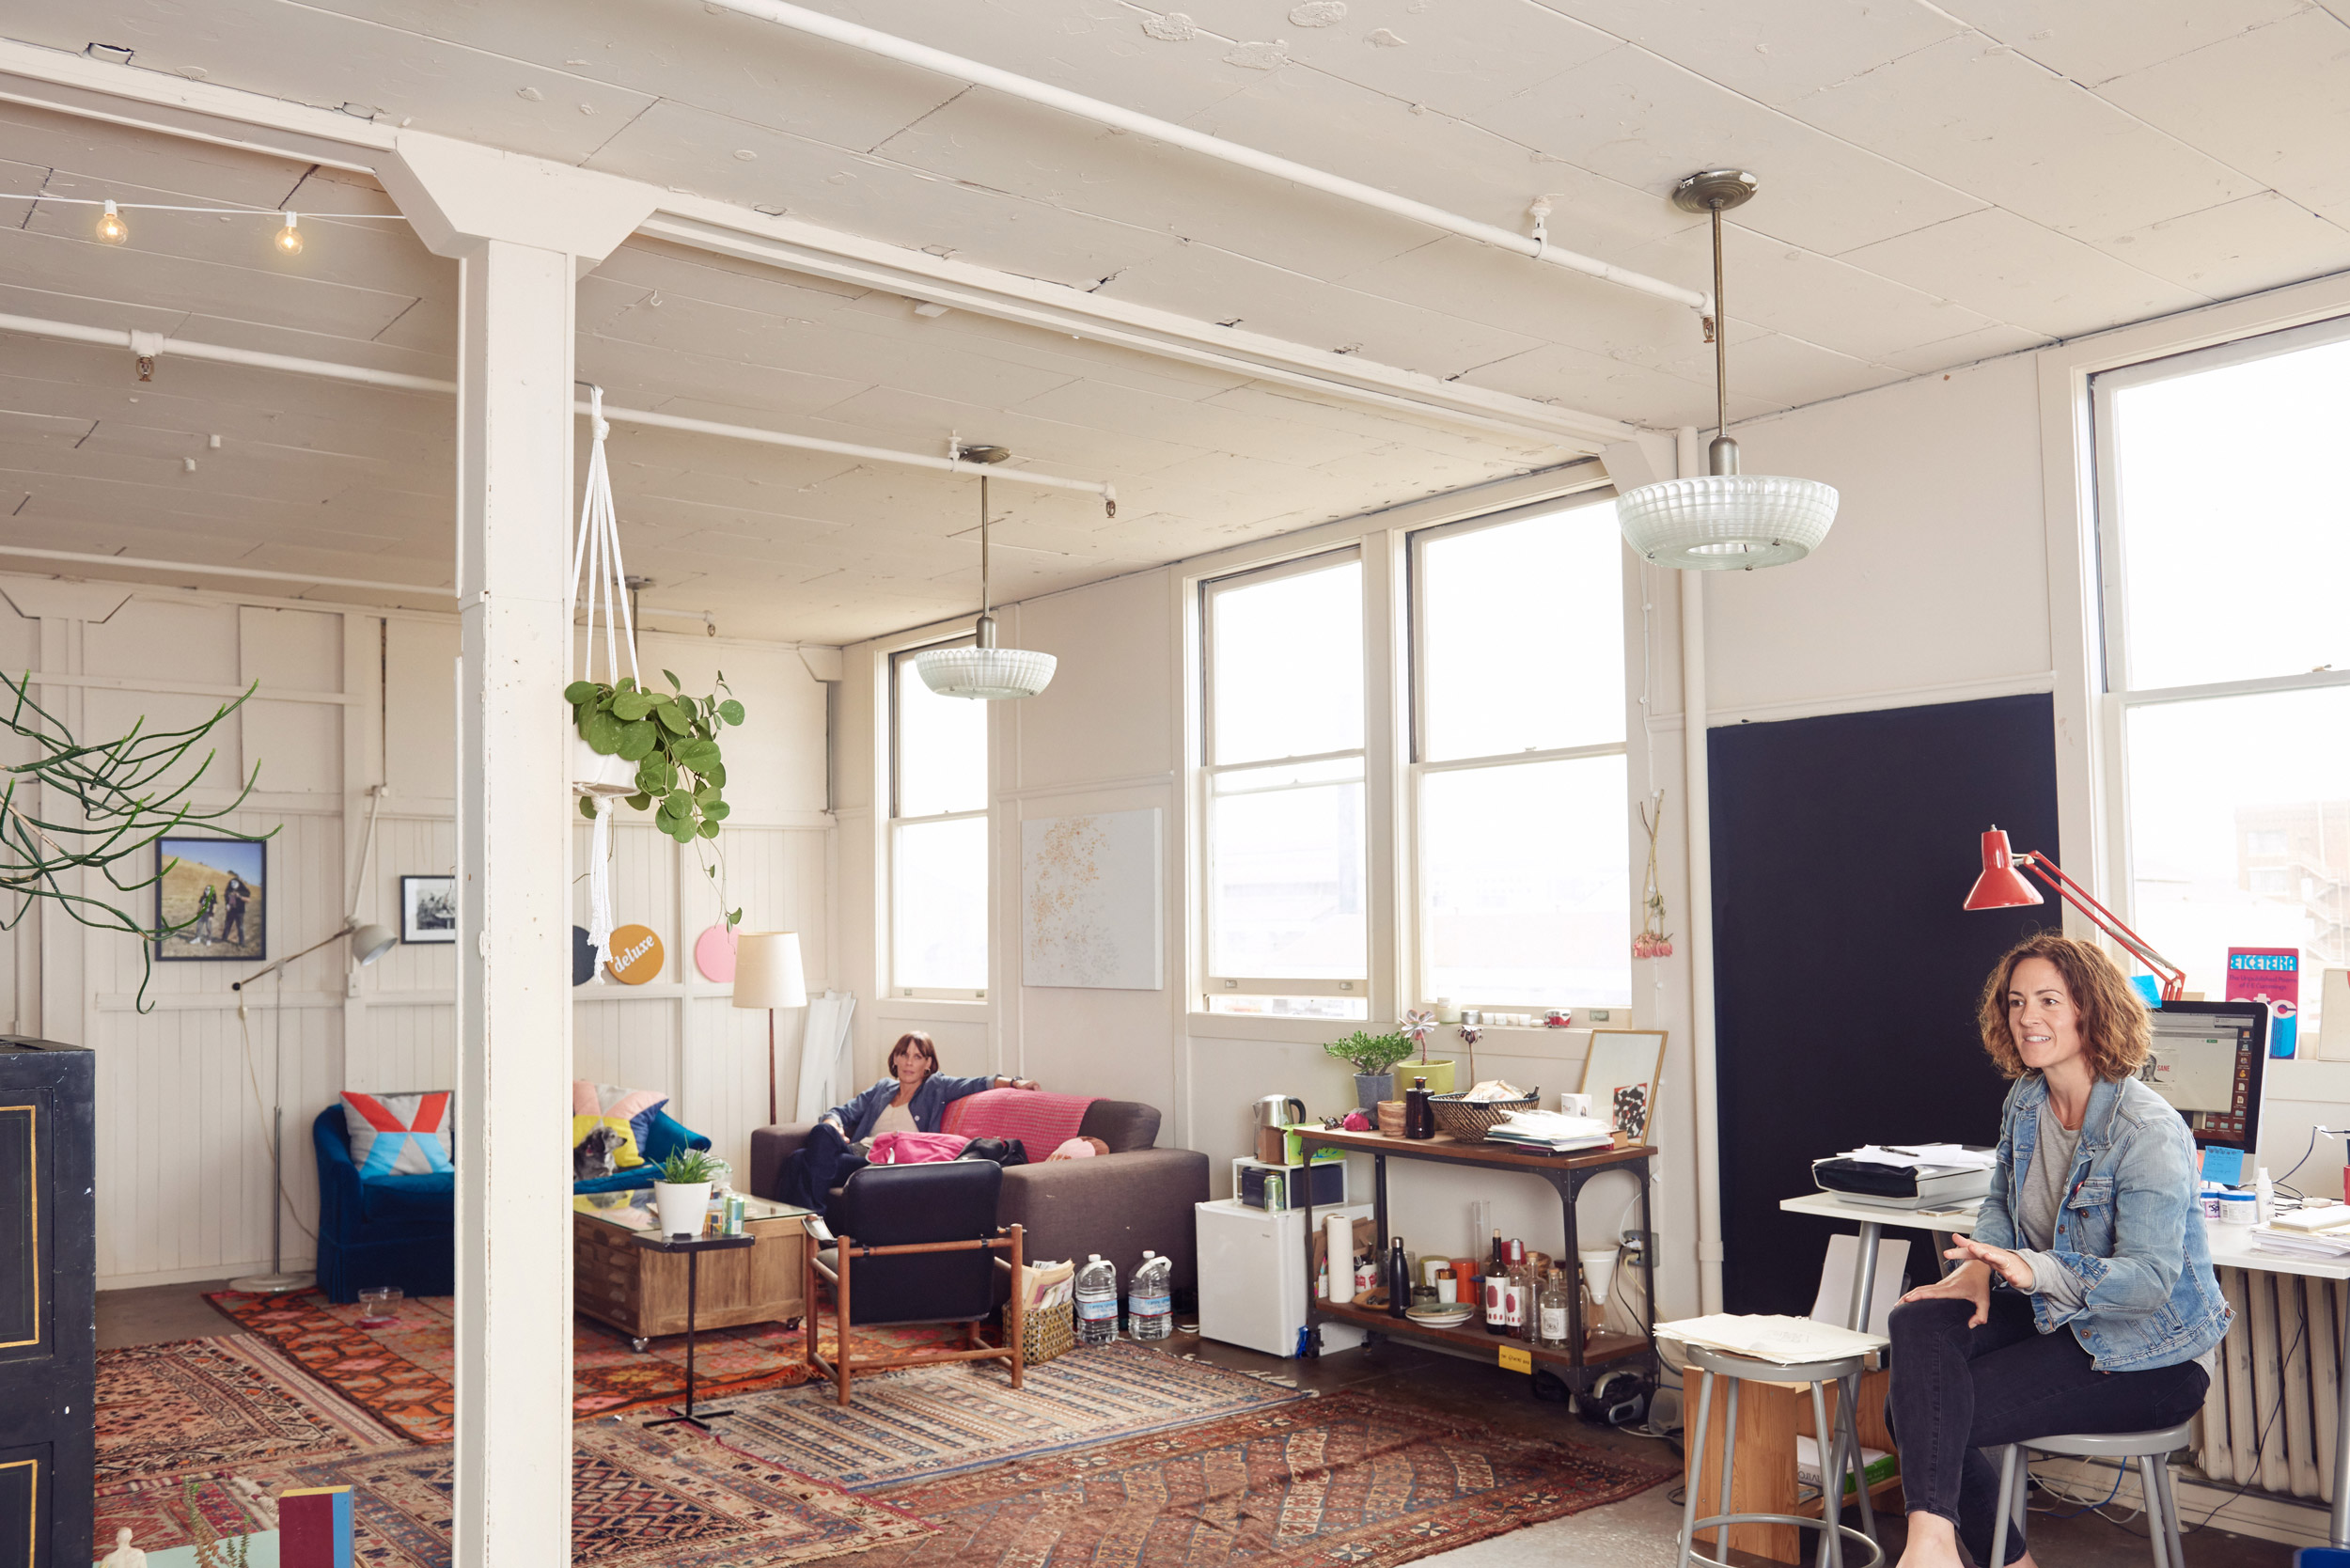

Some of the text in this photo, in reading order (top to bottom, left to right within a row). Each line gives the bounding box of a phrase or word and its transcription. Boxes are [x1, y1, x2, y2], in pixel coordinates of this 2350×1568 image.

[614, 935, 654, 973] deluxe
[2231, 954, 2297, 971] ETCETERA
[2240, 975, 2278, 983] Unpublished
[2255, 982, 2287, 991] Cummings
